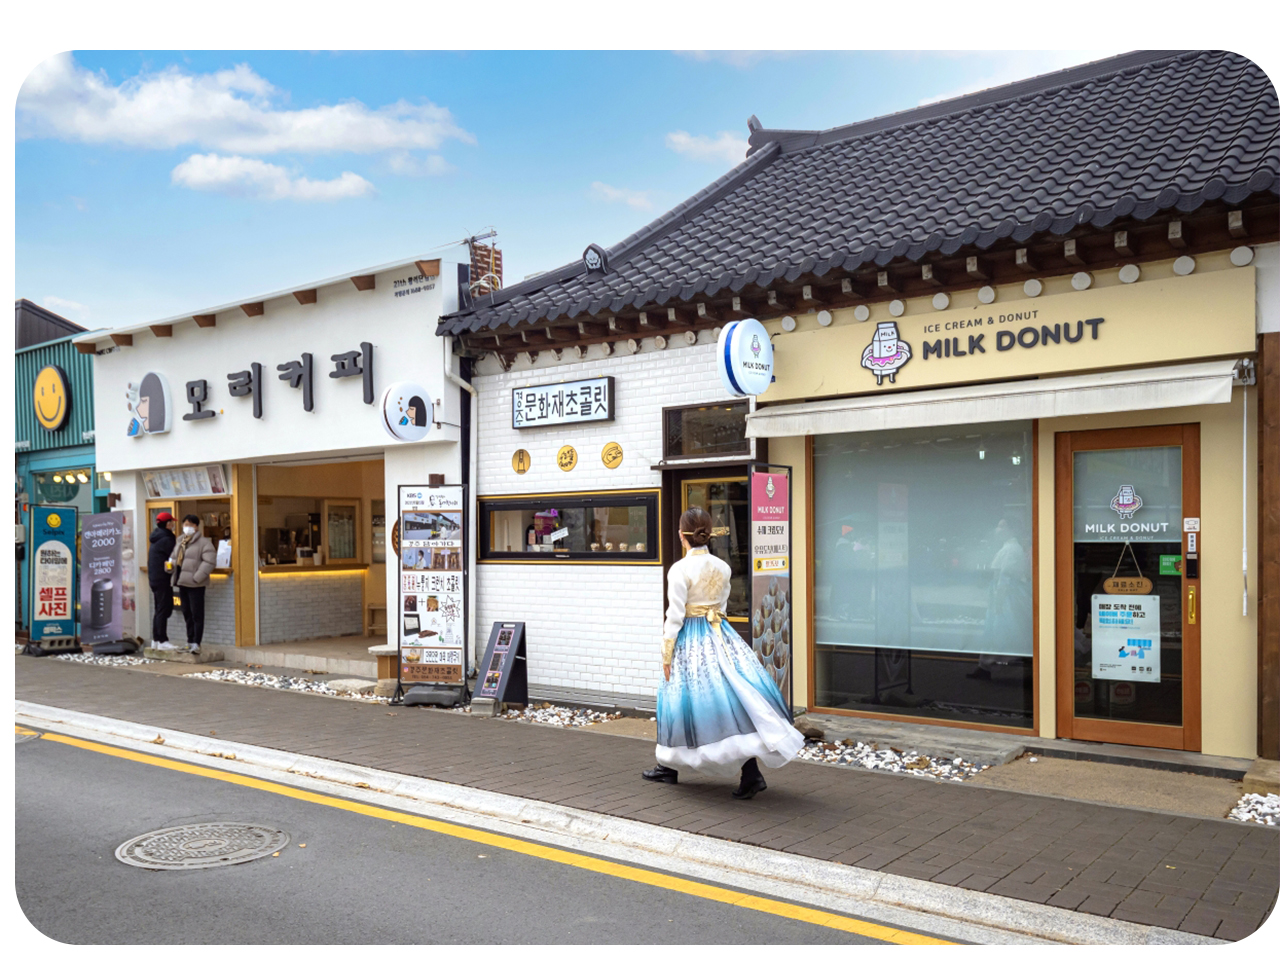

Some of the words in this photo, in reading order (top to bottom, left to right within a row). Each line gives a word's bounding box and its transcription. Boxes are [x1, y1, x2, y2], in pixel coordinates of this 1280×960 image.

[923, 323, 941, 334] ICE
[944, 318, 983, 331] CREAM
[987, 316, 994, 325] &
[999, 310, 1039, 323] DONUT
[922, 333, 986, 361] MILK
[996, 318, 1105, 351] DONUT
[743, 361, 754, 369] MILK
[755, 362, 770, 371] DONUT
[182, 341, 375, 421] 모리커피
[515, 391, 524, 425] 경주
[524, 384, 607, 422] 문화재초콜릿
[769, 506, 785, 514] DONUT
[1085, 523, 1115, 533] MILK
[1120, 523, 1169, 533] DONUT
[92, 537, 115, 548] 2000
[39, 587, 67, 601] 셀프
[39, 602, 67, 616] 사진
